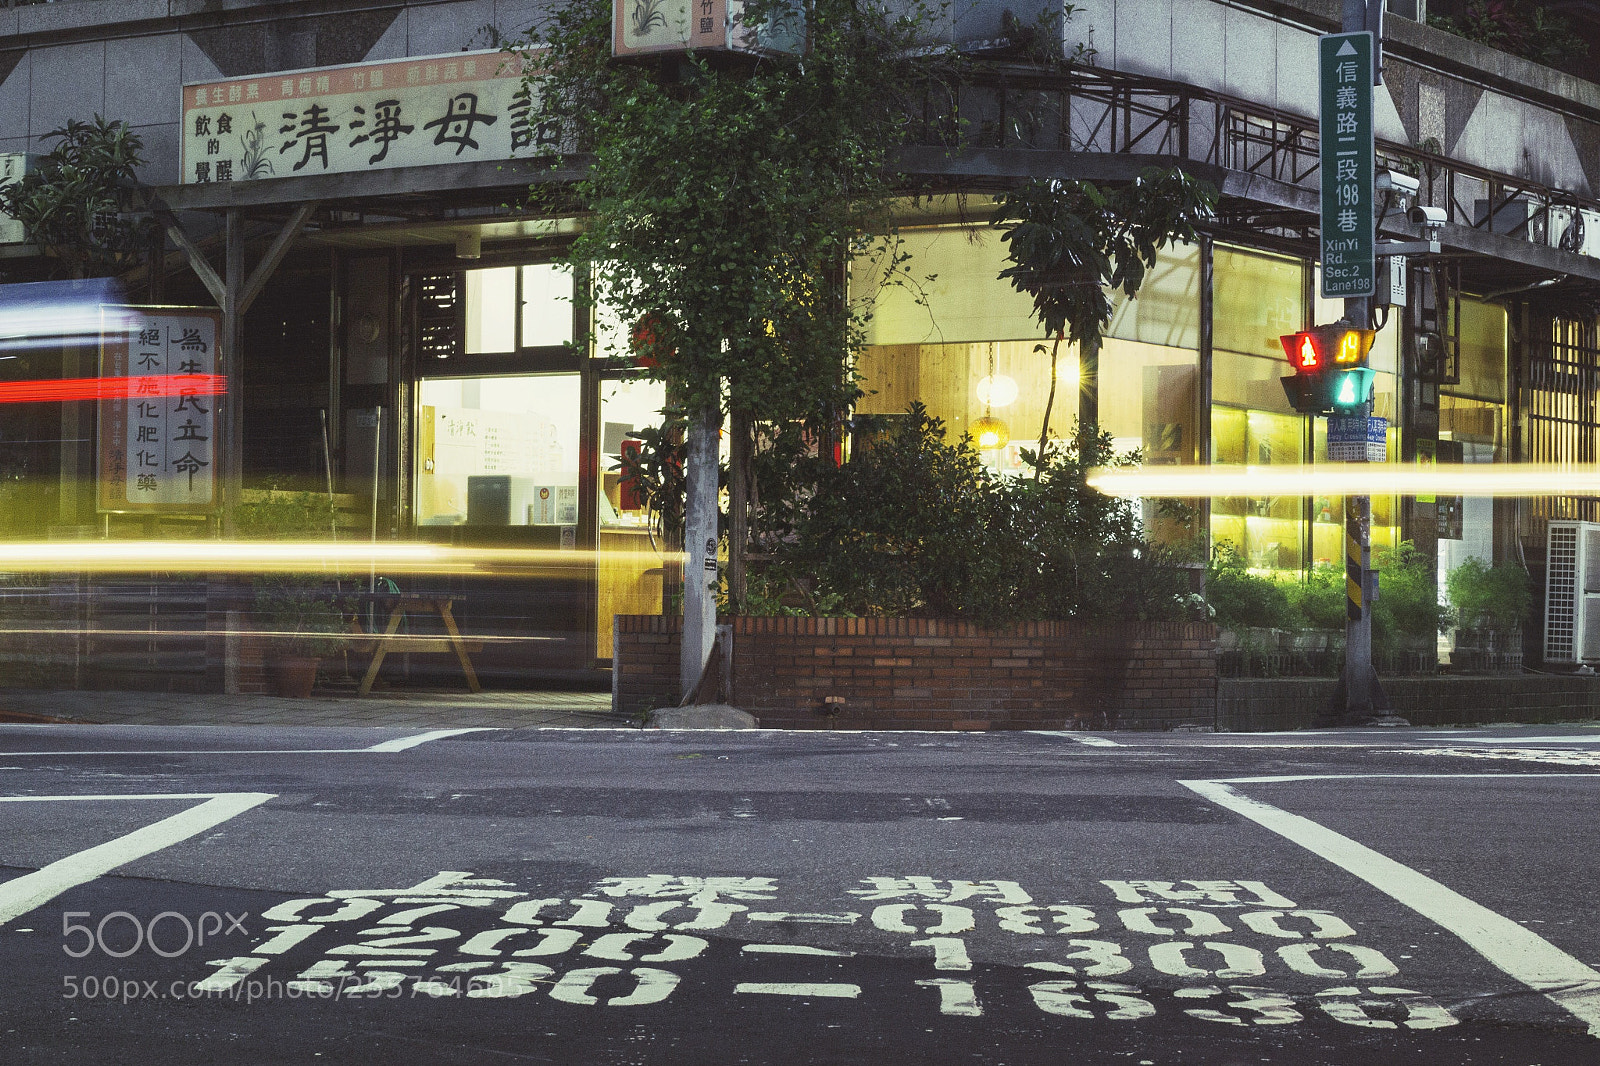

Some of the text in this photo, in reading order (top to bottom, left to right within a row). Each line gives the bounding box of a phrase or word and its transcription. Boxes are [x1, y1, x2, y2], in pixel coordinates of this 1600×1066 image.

[194, 112, 233, 137] 飲食
[207, 138, 220, 155] 的
[1335, 61, 1359, 233] 信義路二段198巷
[194, 159, 233, 184] 覺醒
[1325, 238, 1359, 252] XinYi
[1325, 253, 1347, 265] Rd.
[1325, 265, 1360, 279] Sec.2
[136, 328, 161, 492] 絕不施化肥化藥
